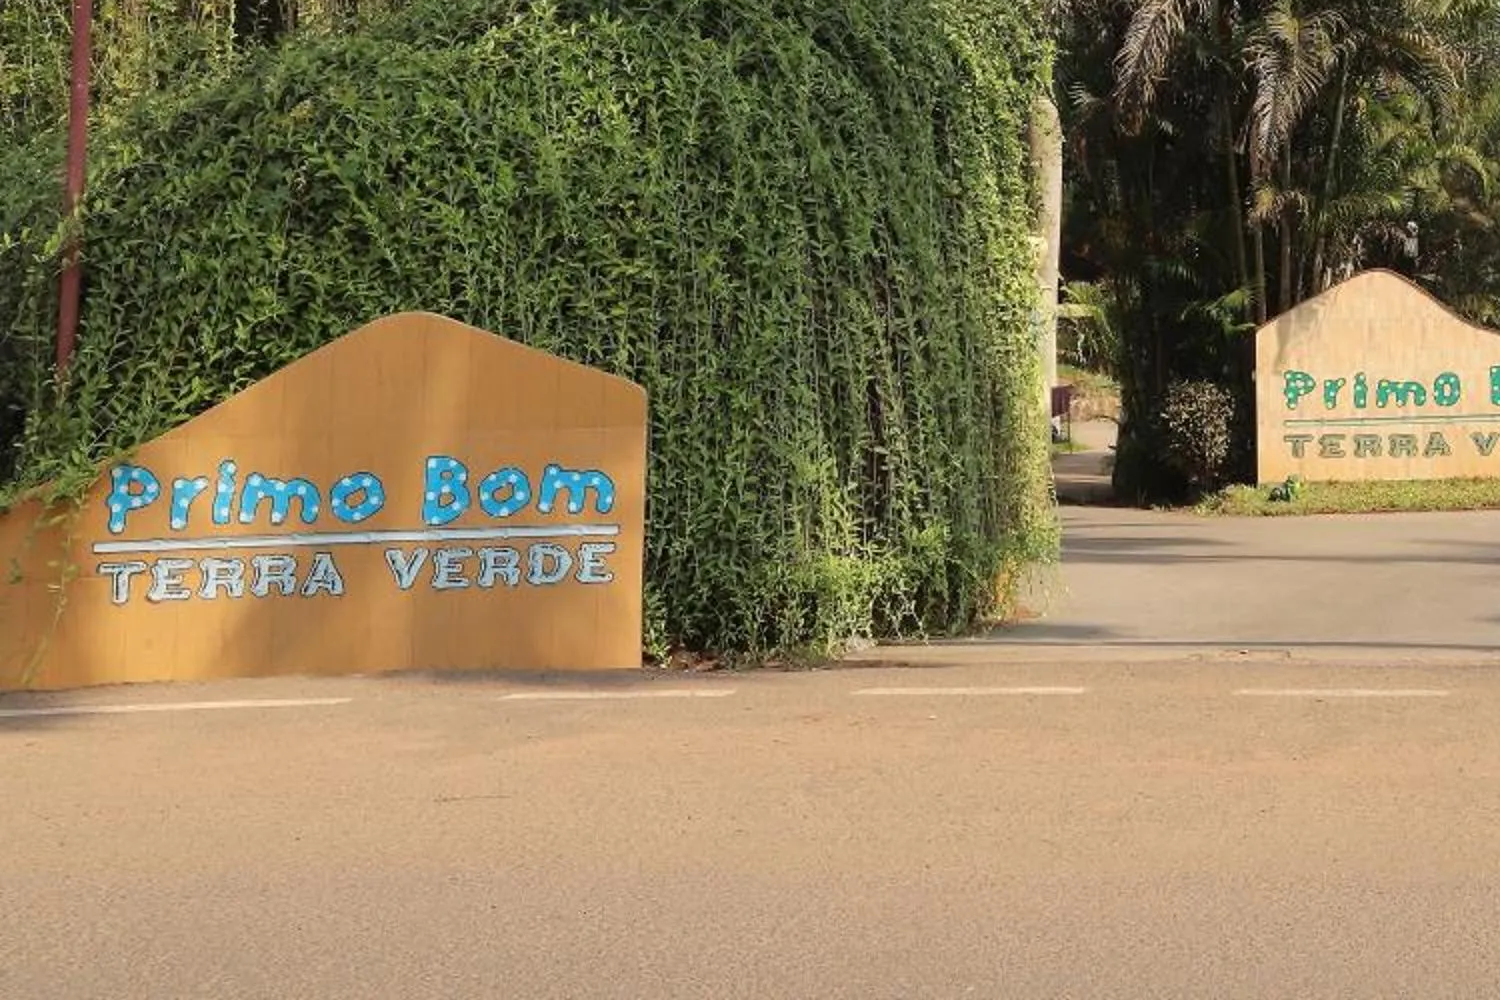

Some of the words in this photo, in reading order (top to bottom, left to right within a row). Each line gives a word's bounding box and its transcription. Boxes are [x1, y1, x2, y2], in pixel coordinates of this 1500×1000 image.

[1282, 369, 1462, 409] Primo
[1283, 431, 1453, 459] TERRA
[105, 458, 385, 534] Primo
[421, 455, 617, 526] Bom
[99, 551, 345, 605] TERRA
[384, 541, 617, 591] VERDE
